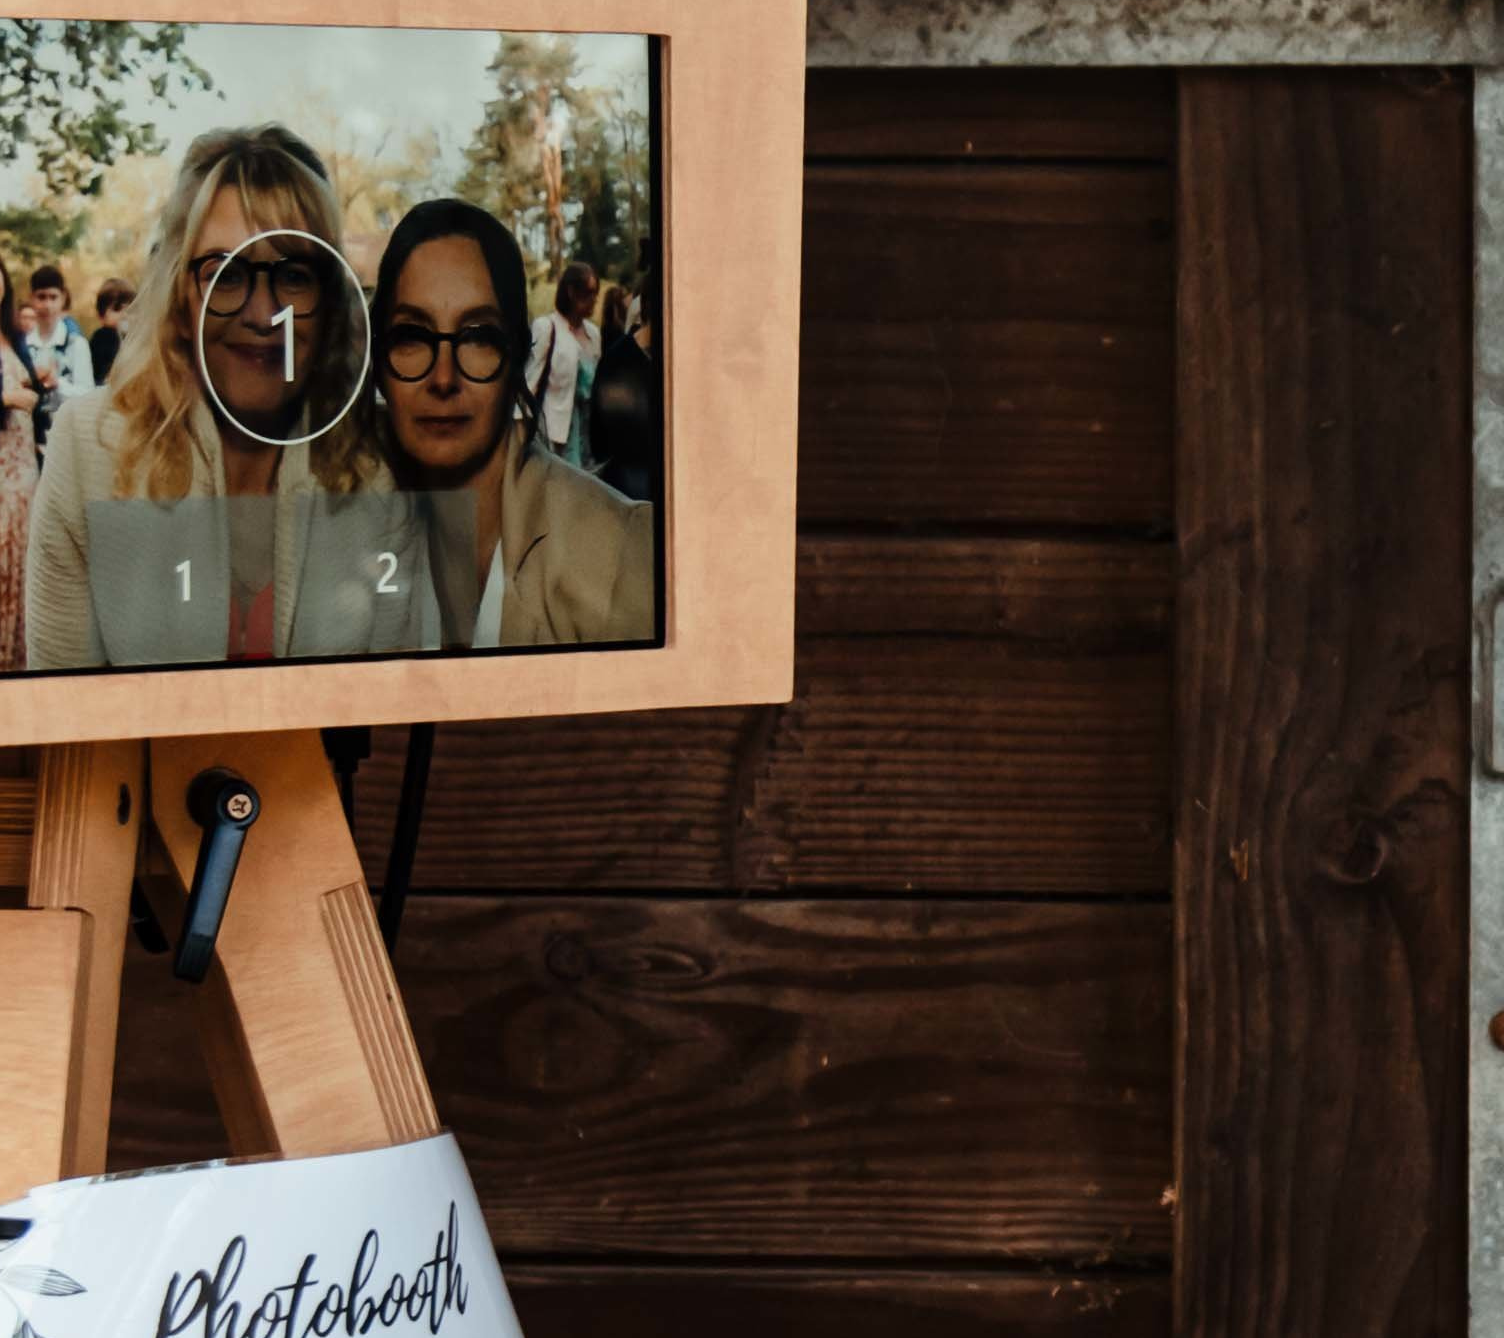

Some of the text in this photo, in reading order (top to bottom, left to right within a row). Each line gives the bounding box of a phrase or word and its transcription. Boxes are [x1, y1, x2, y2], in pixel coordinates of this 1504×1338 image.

[269, 304, 295, 382] 1
[174, 559, 192, 602] 1
[375, 552, 398, 593] 2
